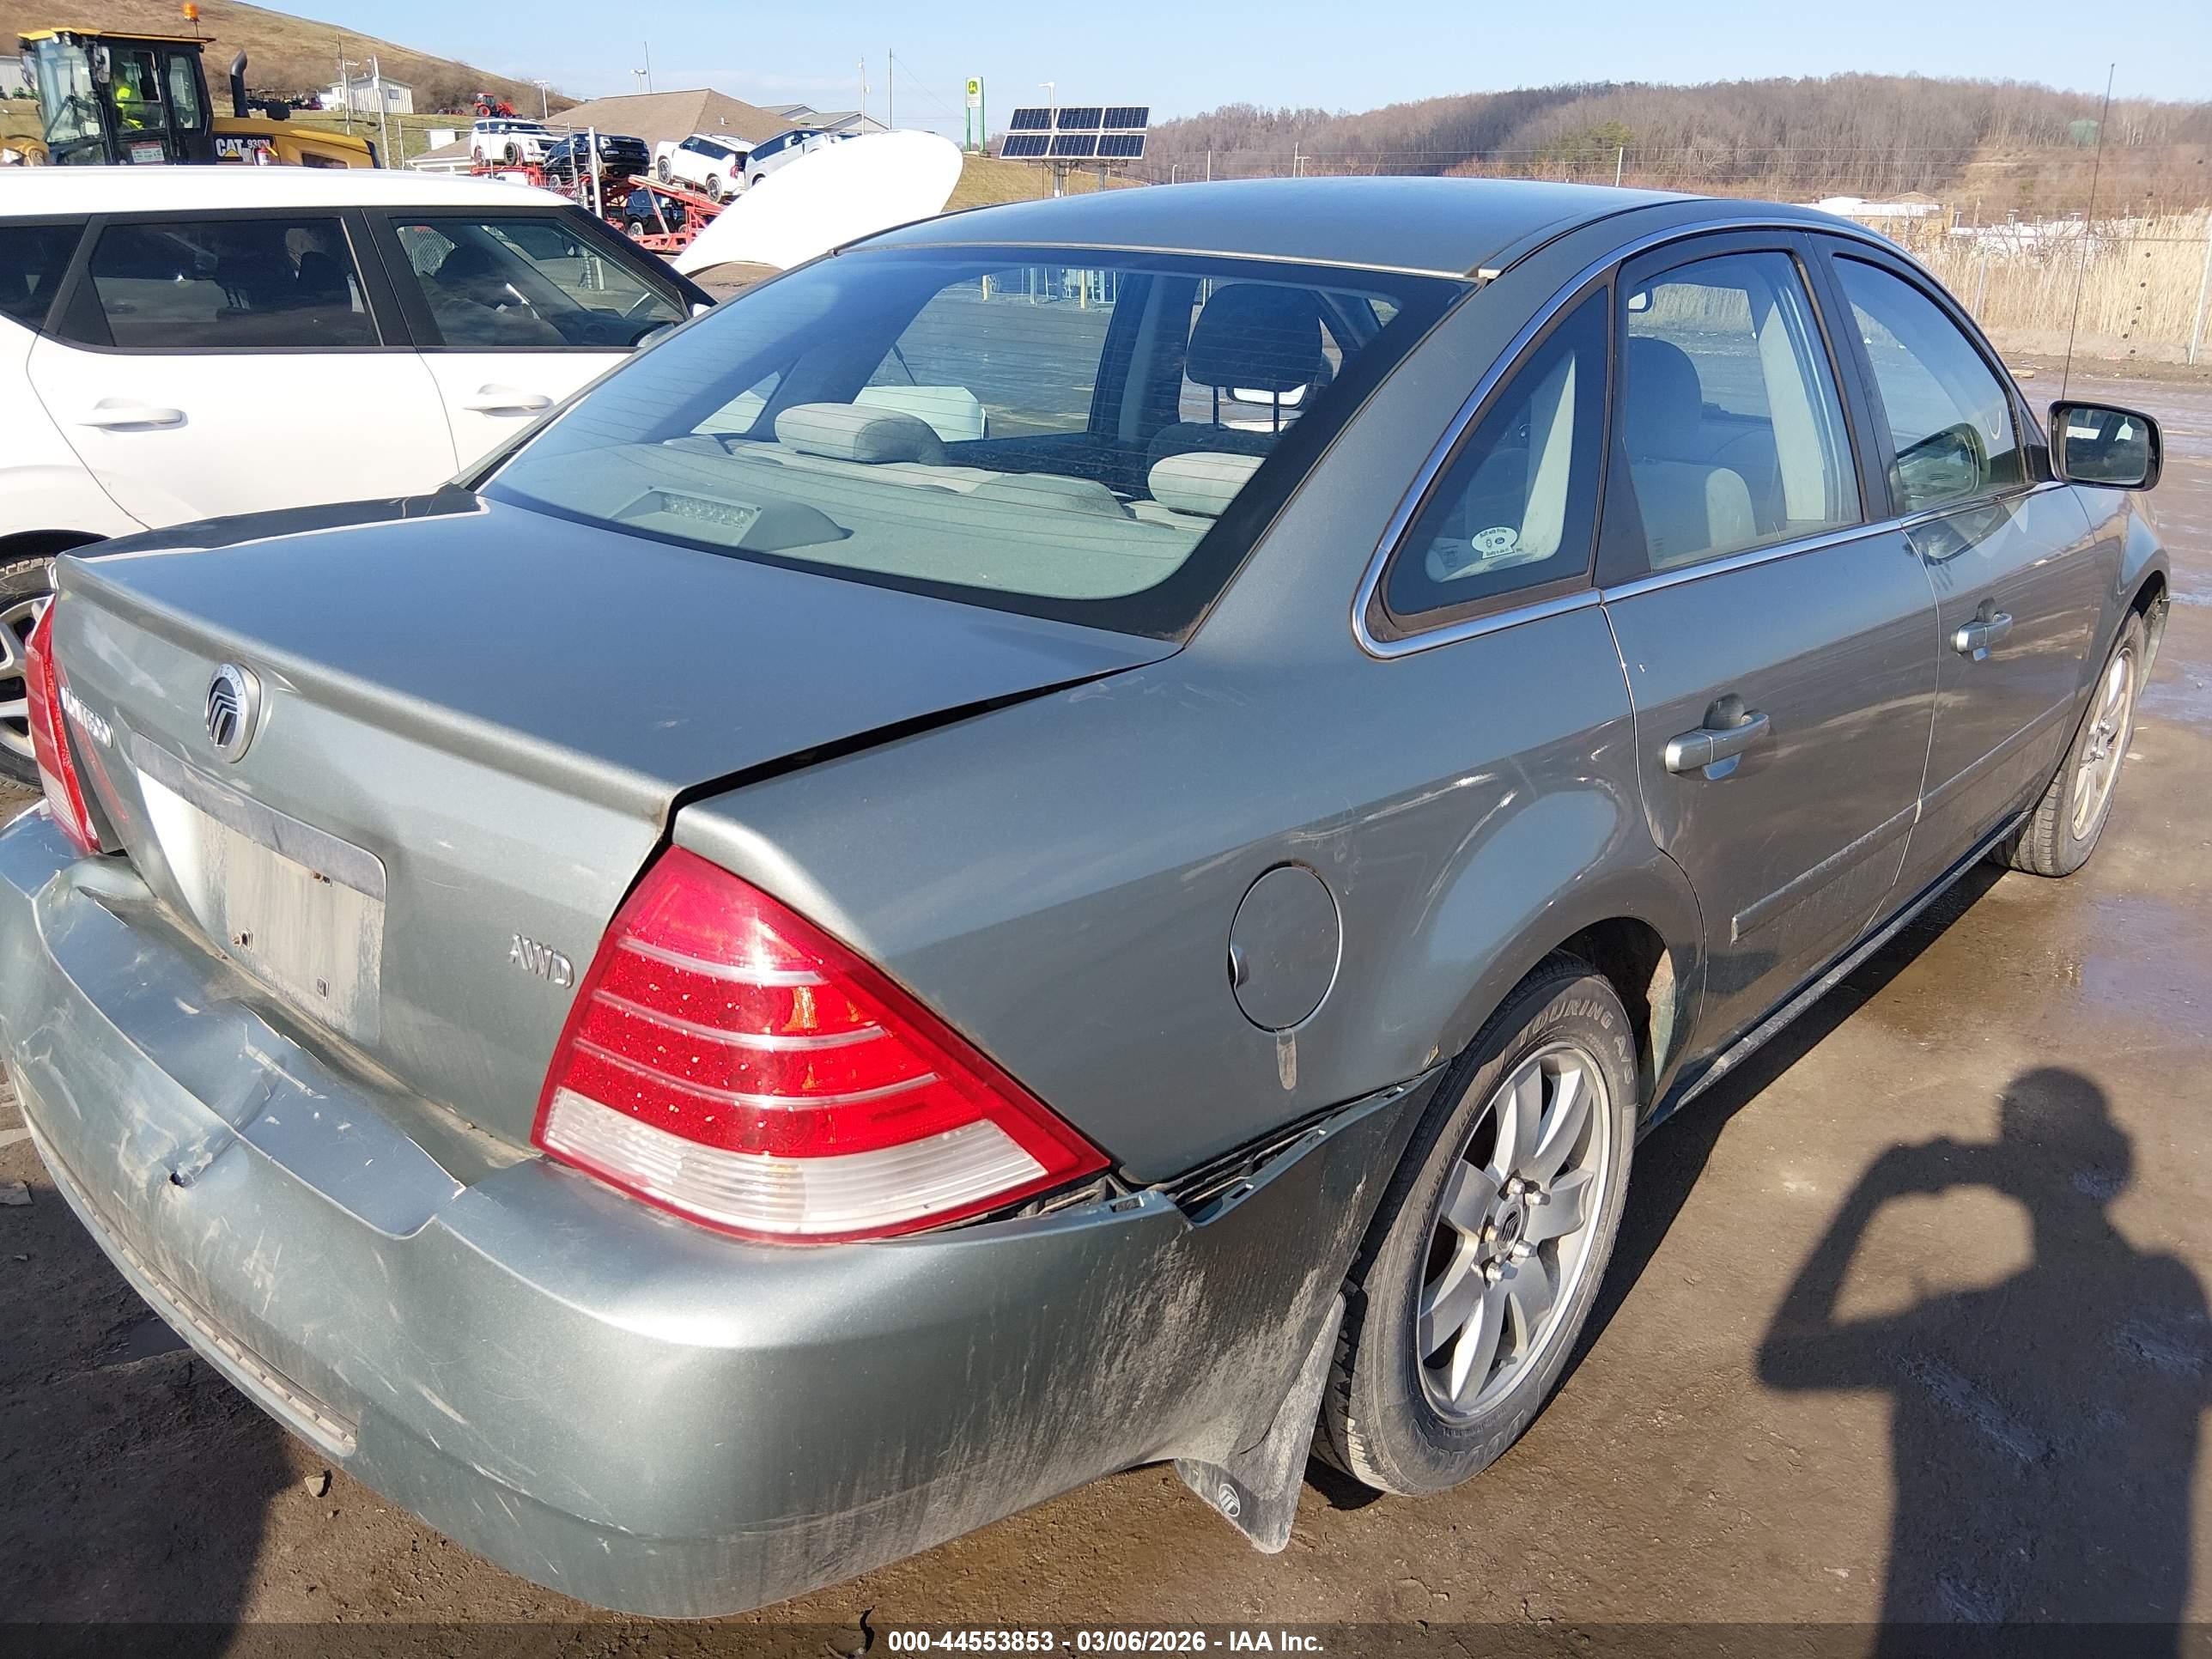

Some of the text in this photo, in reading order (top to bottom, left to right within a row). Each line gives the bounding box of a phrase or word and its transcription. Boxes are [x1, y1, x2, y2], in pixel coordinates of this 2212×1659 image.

[216, 138, 244, 157] CAT
[209, 665, 244, 696] RCURY
[509, 933, 574, 989] AWD
[1518, 1000, 1614, 1048] TOURING
